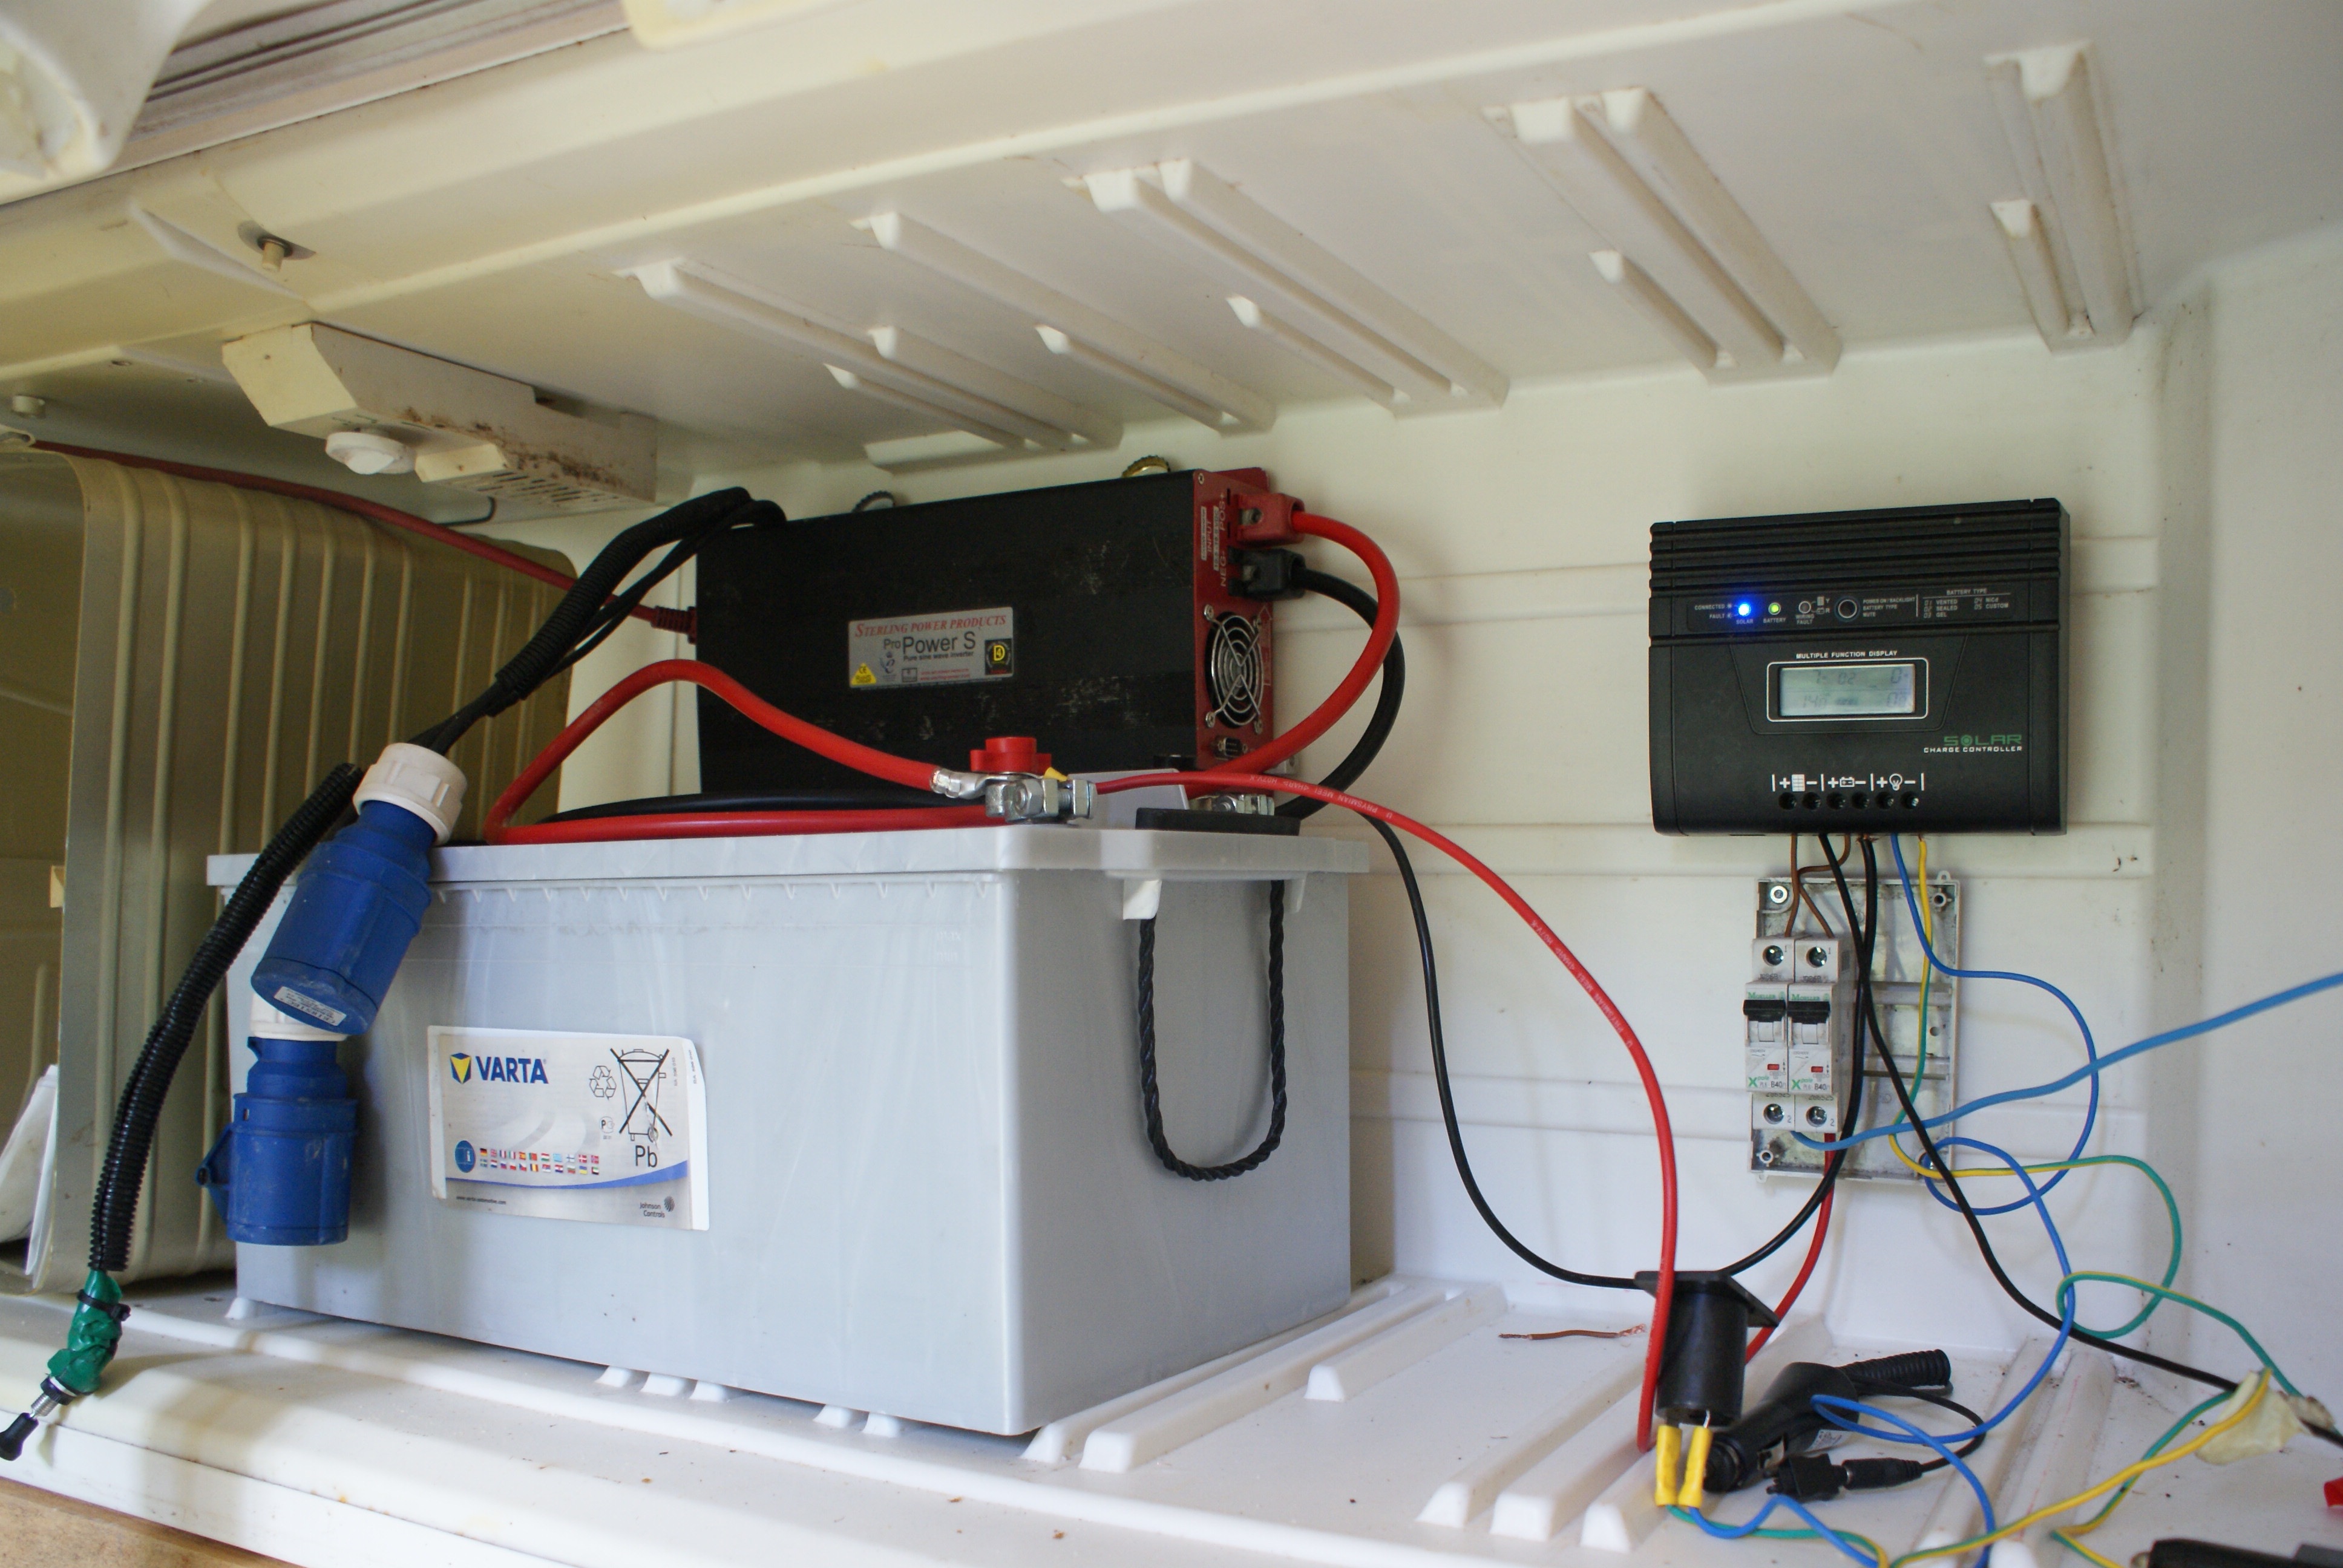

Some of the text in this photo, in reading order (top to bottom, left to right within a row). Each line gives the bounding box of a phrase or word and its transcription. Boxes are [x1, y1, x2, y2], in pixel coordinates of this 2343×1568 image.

[911, 619, 947, 632] POWER
[949, 615, 1006, 629] PRODUCTS
[963, 631, 975, 650] S
[1943, 734, 2022, 746] SOLAR
[1337, 794, 1378, 813] PRYSMIAN
[475, 1056, 549, 1084] VARTA
[1787, 1115, 1792, 1123] 2
[634, 1145, 658, 1168] Pb
[643, 1210, 666, 1218] Controls
